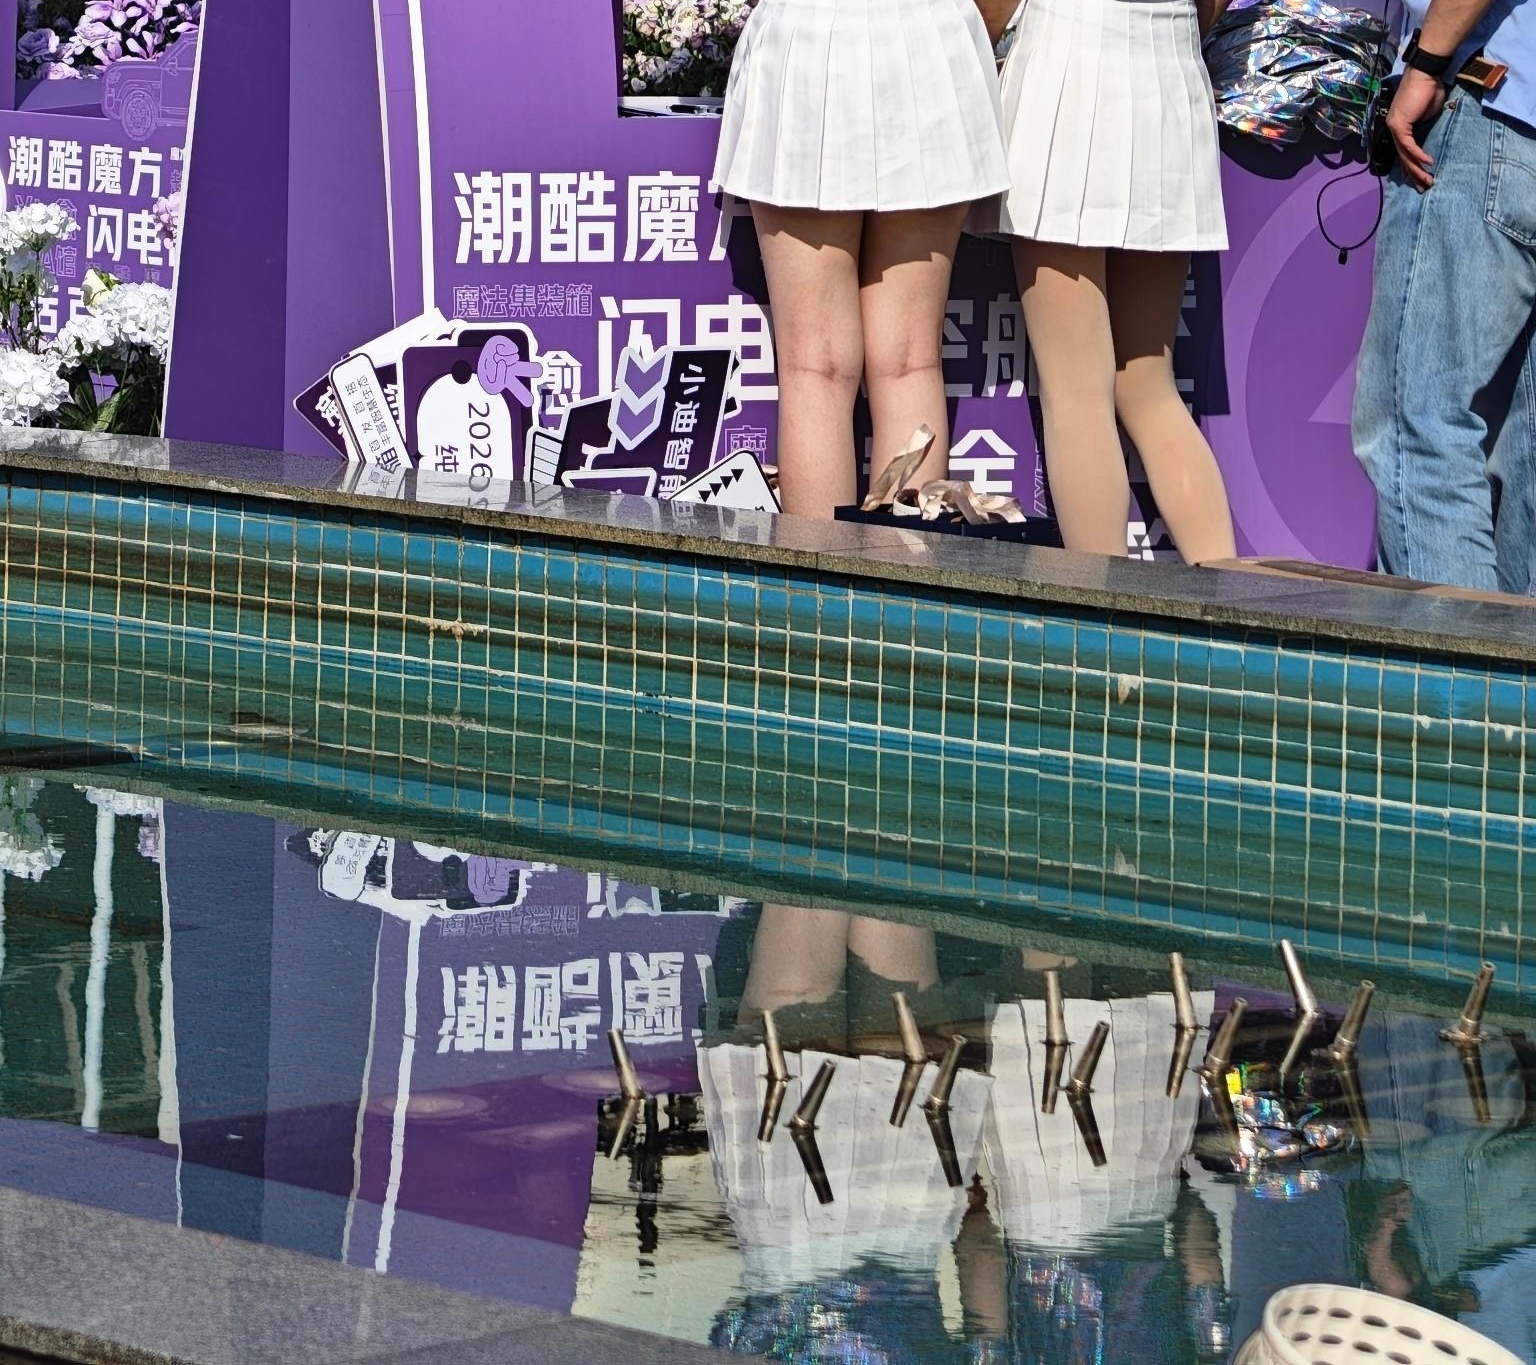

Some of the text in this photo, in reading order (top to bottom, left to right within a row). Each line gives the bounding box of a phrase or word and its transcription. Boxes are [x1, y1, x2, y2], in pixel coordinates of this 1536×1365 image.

[7, 135, 163, 199] 潮酷魔方
[452, 283, 593, 319] 魔法集装箱
